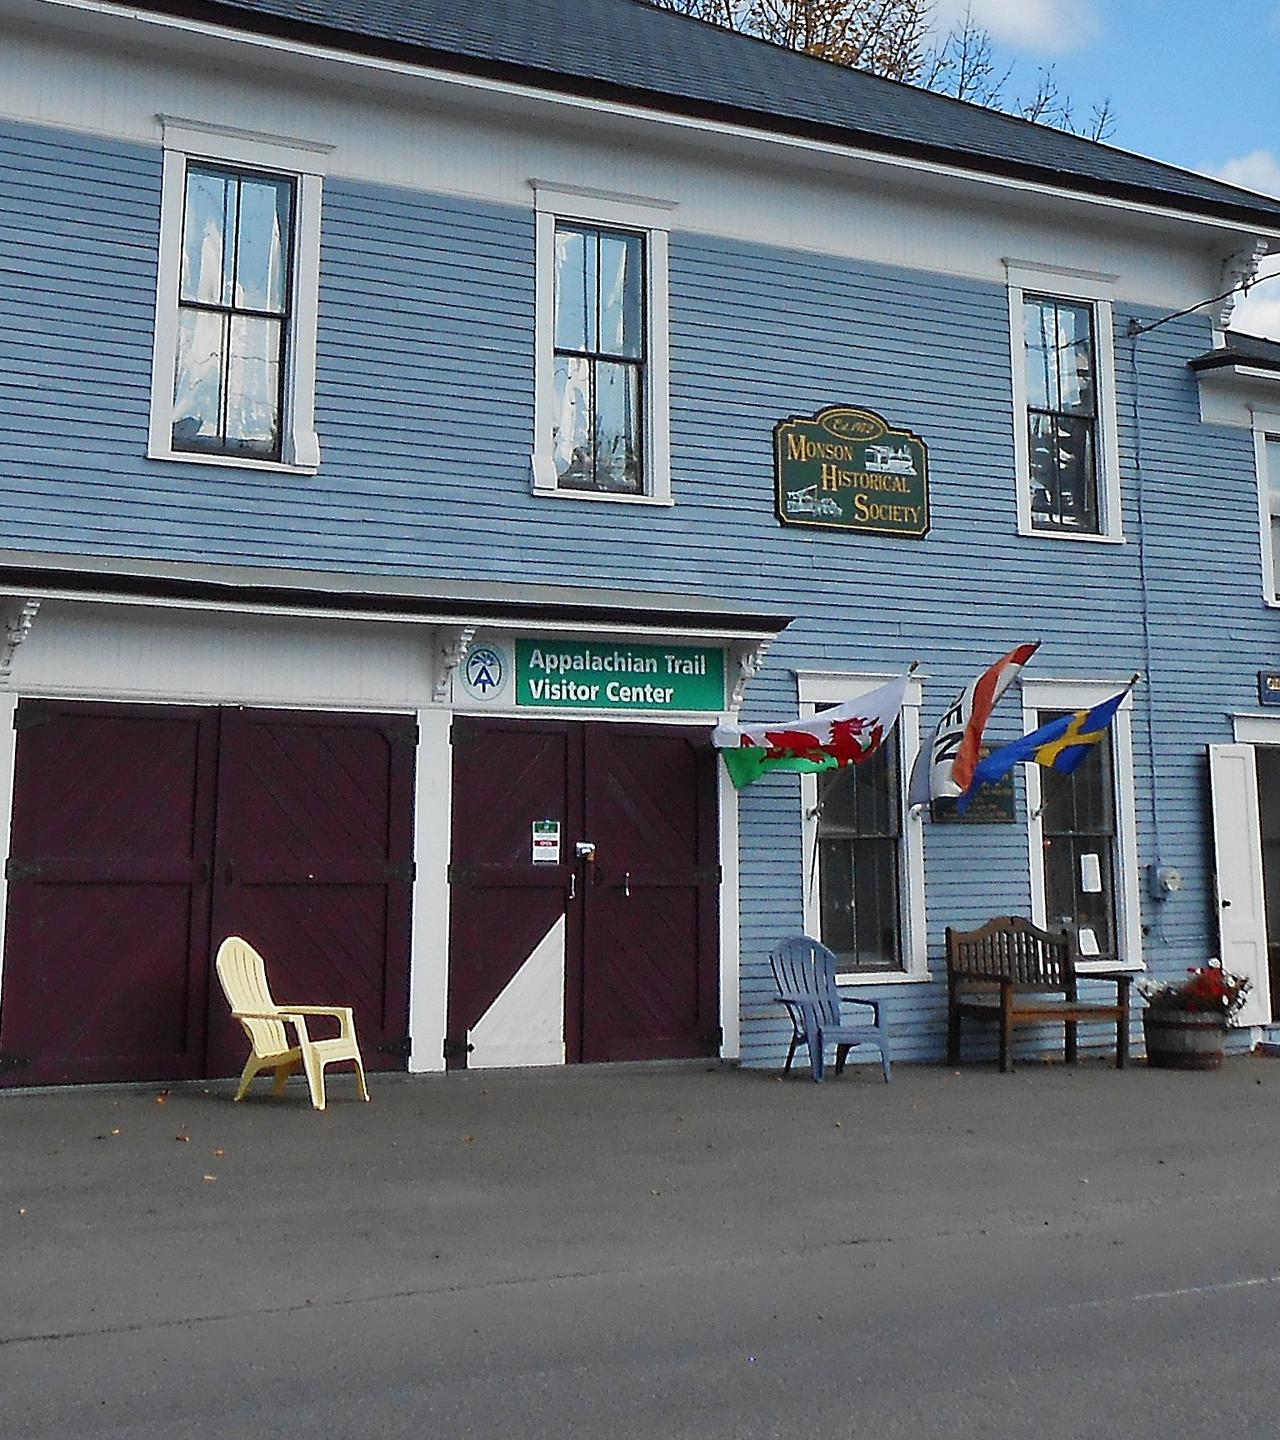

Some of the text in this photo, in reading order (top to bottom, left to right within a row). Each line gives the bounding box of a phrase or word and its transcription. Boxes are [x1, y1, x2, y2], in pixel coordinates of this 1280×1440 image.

[787, 433, 853, 461] MONSON
[821, 463, 911, 493] HISTORICAL
[854, 493, 921, 523] SOCIETY
[529, 649, 706, 675] Appalachian Trail
[529, 678, 673, 703] Visitor Center
